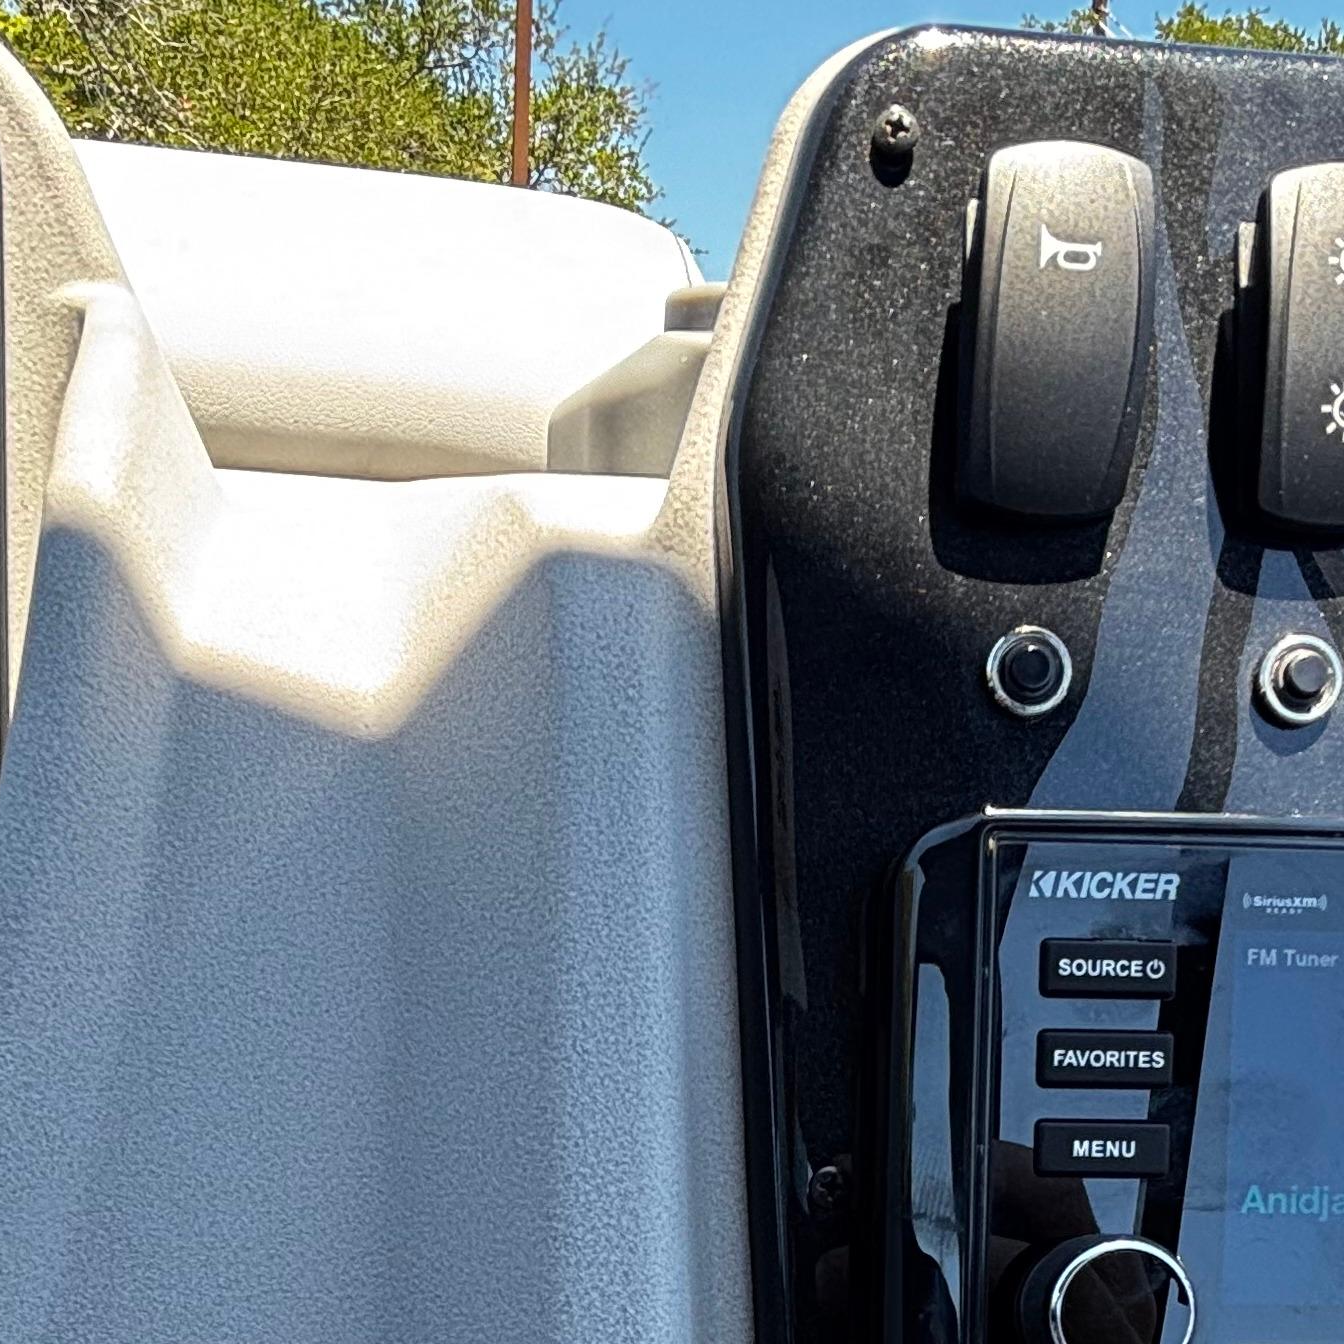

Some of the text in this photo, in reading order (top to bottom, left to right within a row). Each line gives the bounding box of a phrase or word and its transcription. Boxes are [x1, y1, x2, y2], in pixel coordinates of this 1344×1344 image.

[1058, 872, 1180, 900] KICKER
[1058, 958, 1143, 978] SOURCE
[1247, 948, 1340, 968] FM Tuner
[1053, 1049, 1165, 1069] FAVORITES
[1072, 1140, 1136, 1158] MENU
